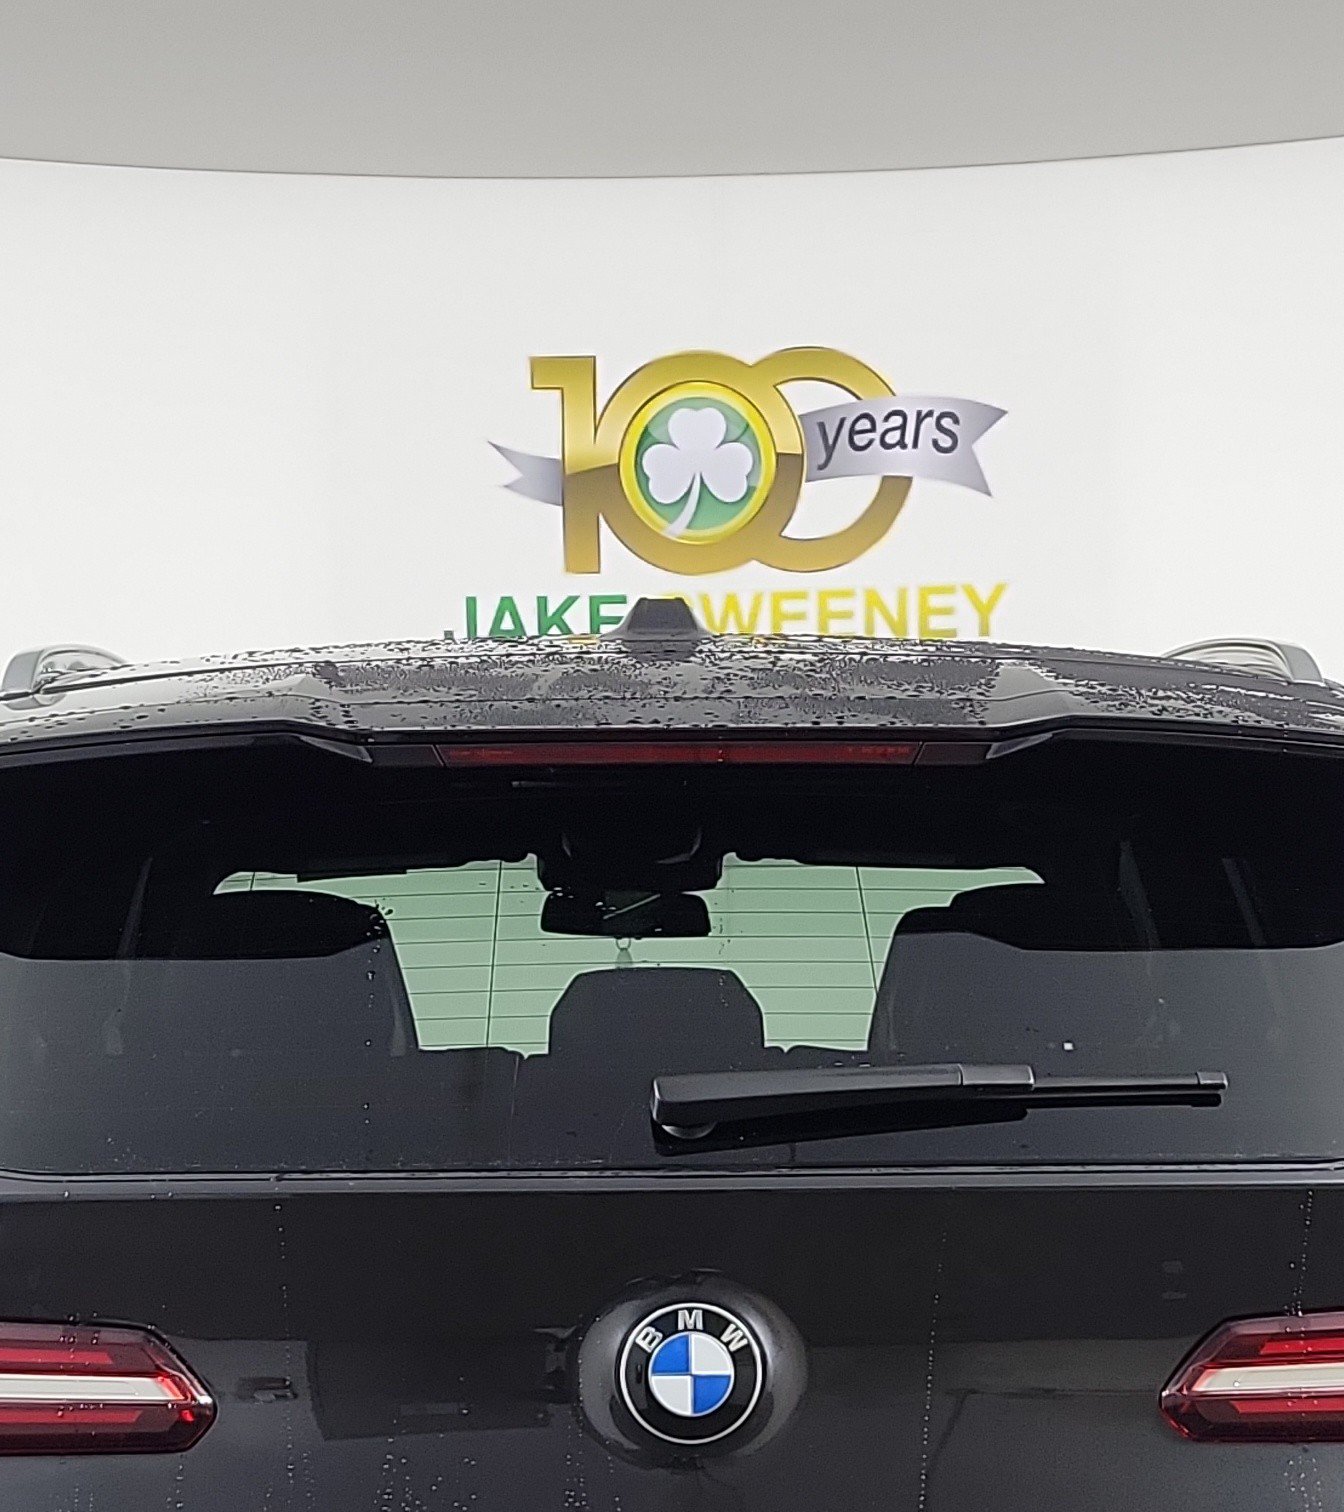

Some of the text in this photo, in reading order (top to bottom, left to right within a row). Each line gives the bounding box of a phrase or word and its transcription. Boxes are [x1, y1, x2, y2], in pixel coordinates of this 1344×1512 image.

[528, 345, 914, 575] 100
[816, 407, 961, 470] years
[660, 582, 1009, 638] WEENEY
[635, 1309, 749, 1353] BMW
